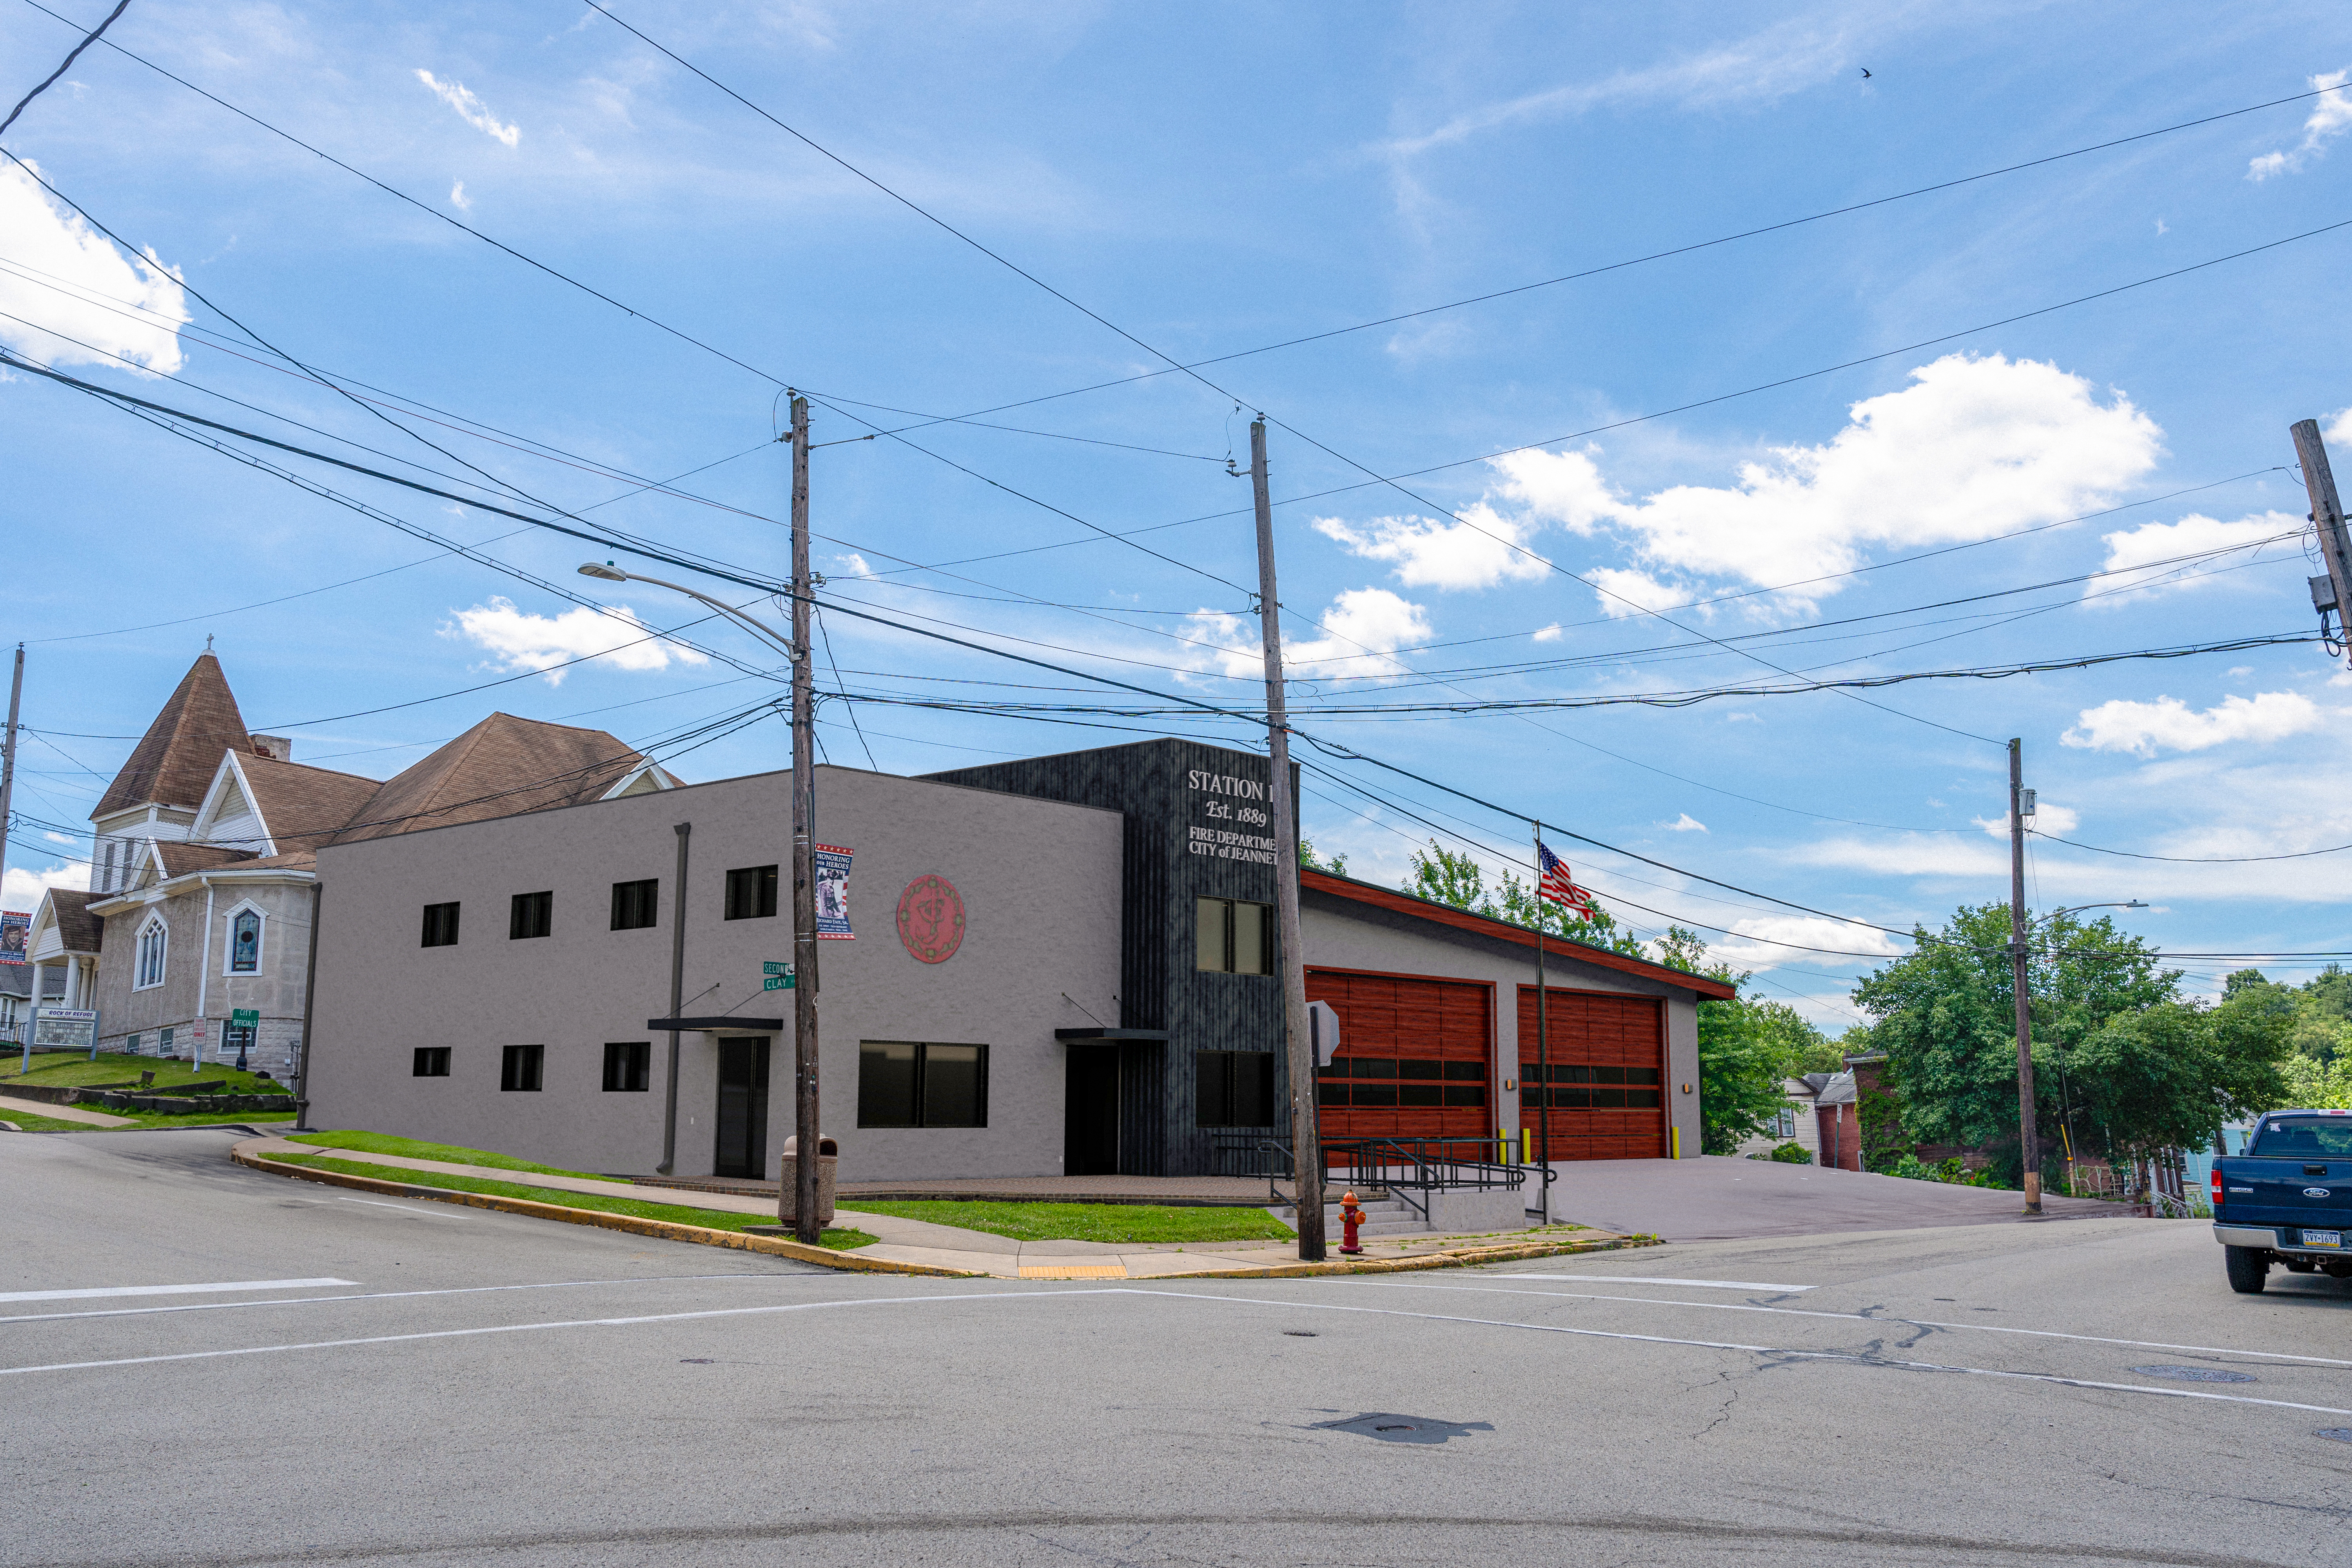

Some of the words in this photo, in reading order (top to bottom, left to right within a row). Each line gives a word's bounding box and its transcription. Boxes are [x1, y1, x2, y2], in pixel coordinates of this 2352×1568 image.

[1189, 769, 1264, 801] STATION
[1206, 801, 1232, 820] Est.
[1236, 808, 1267, 827] 1889
[1189, 826, 1215, 842] FIRE
[1217, 830, 1276, 851] DEPARTME
[817, 853, 850, 863] HONORING
[826, 861, 849, 869] HEROES
[1189, 841, 1217, 857] CITY
[1218, 845, 1230, 858] of
[1230, 847, 1277, 865] JEANNET
[767, 978, 787, 989] CLAY
